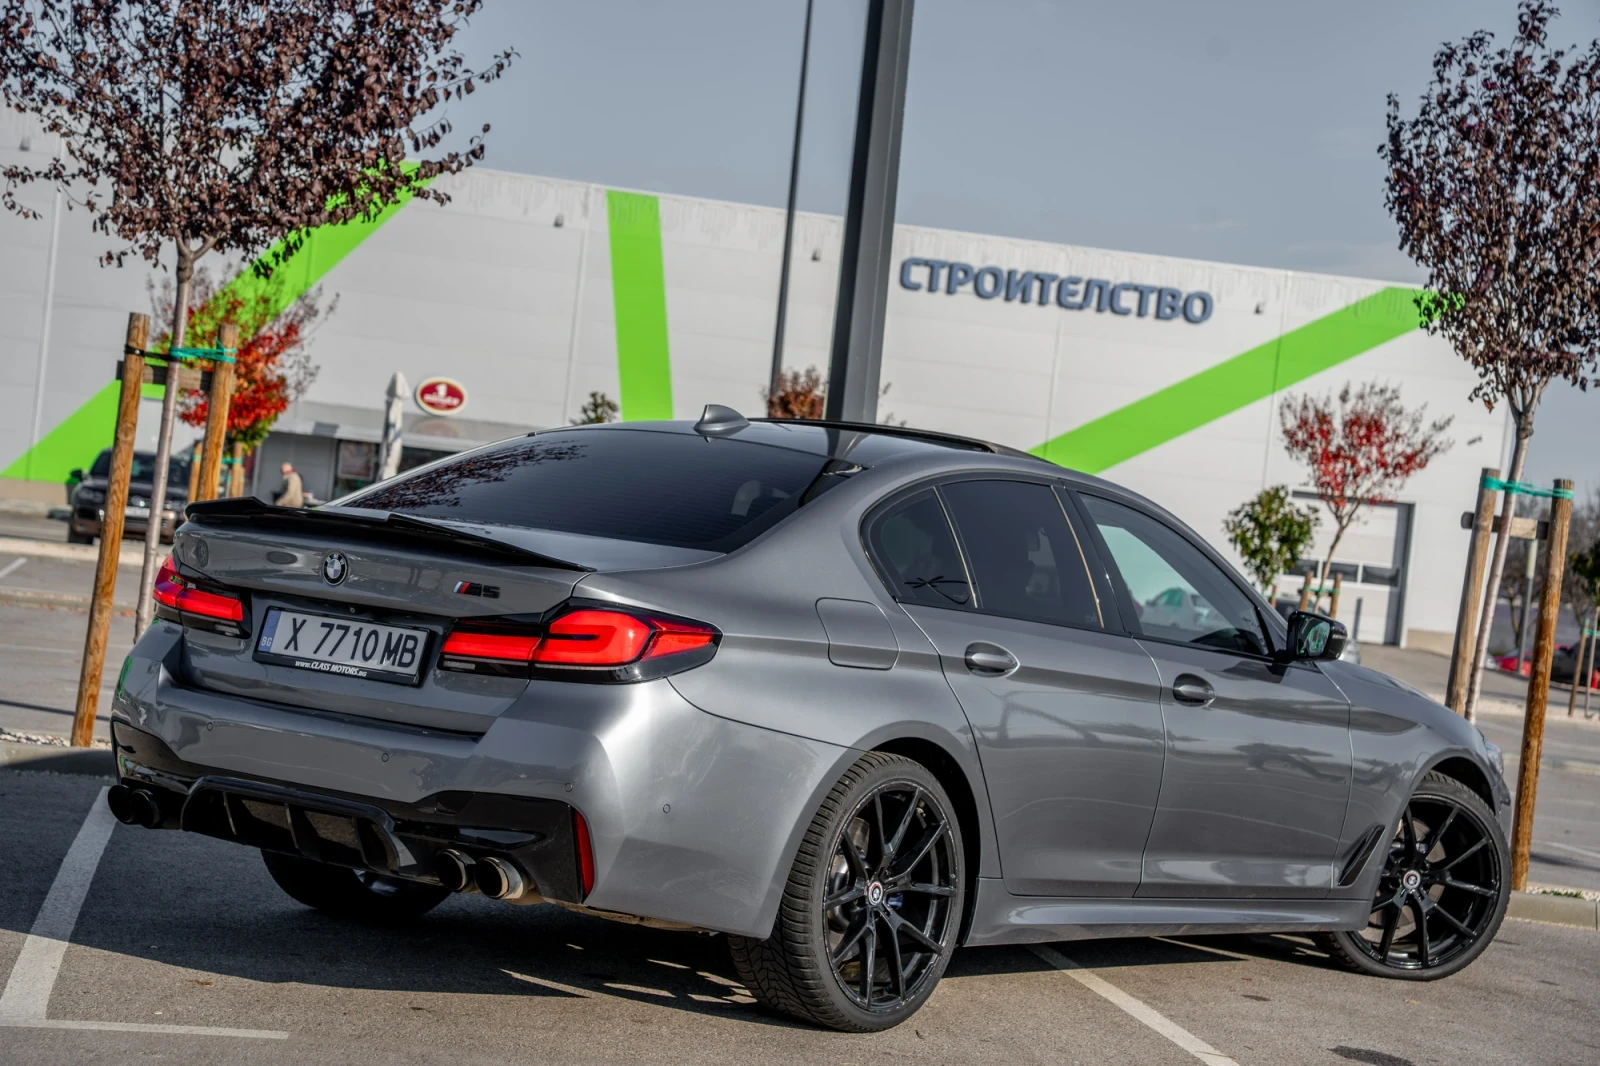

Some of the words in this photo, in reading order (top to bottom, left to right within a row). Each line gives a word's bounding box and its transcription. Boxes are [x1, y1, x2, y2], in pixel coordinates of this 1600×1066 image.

[899, 256, 1214, 324] СТРОИТЕЛСТВО
[261, 636, 272, 647] BG
[284, 617, 307, 651] X
[313, 622, 379, 662] 7710
[381, 631, 419, 668] MB
